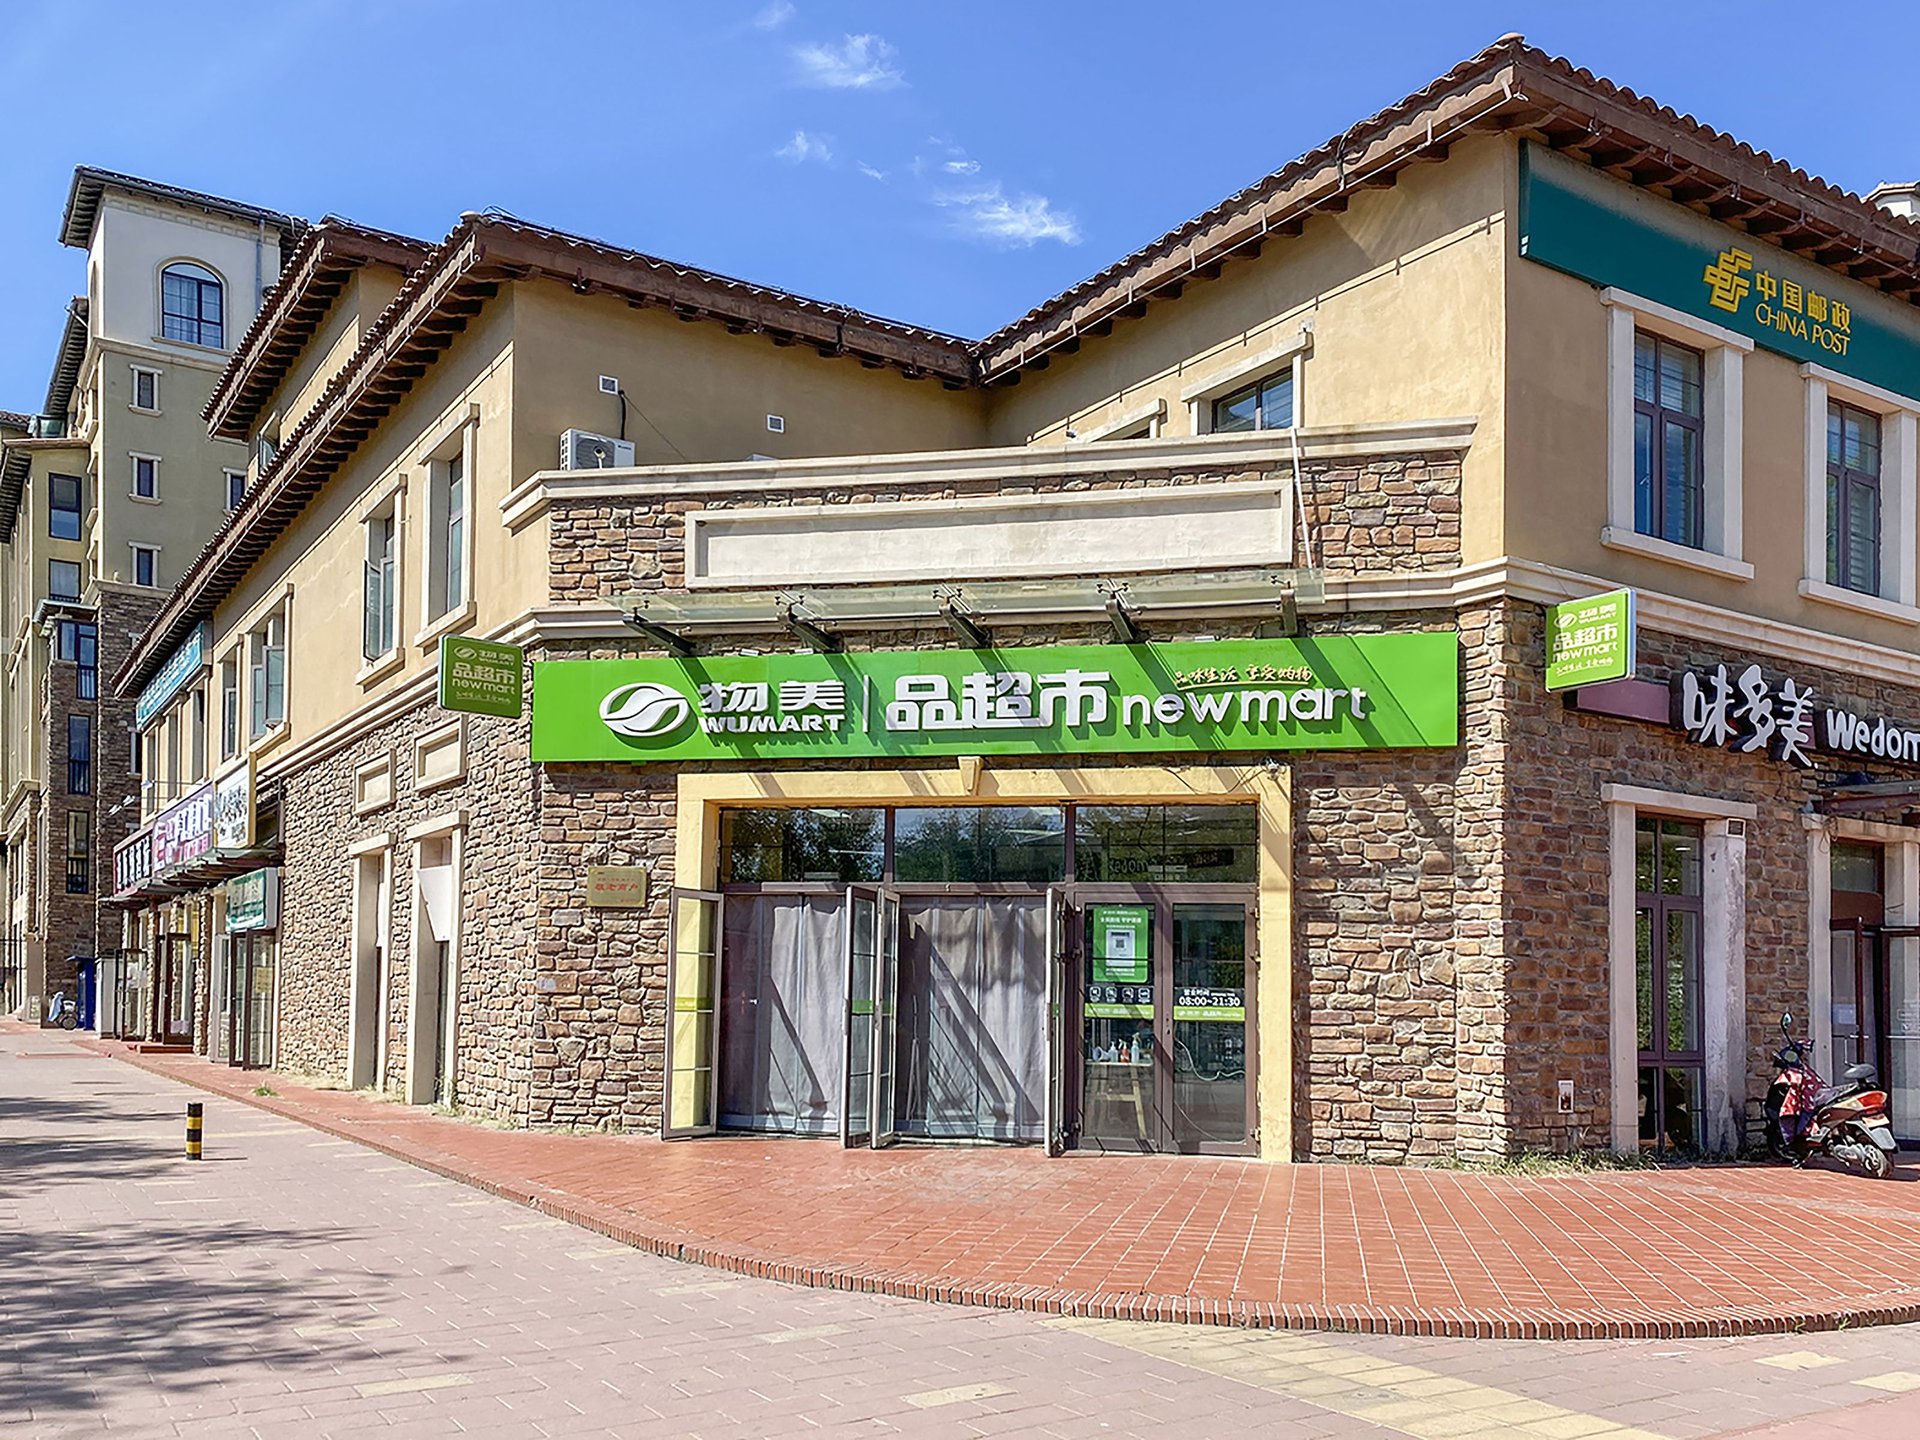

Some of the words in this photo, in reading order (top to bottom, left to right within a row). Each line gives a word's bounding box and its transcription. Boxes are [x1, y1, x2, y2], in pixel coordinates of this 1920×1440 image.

[1755, 270, 1851, 334] 中国邮政
[1755, 303, 1808, 341] CHINA
[1812, 324, 1851, 356] POST
[1553, 622, 1618, 651] 品超市
[452, 662, 516, 684] 品超市
[697, 680, 845, 713] 物美
[885, 669, 1109, 731] 品超市
[1123, 686, 1367, 726] newmart
[1682, 663, 1818, 769] 味多美
[699, 714, 845, 734] WUMART
